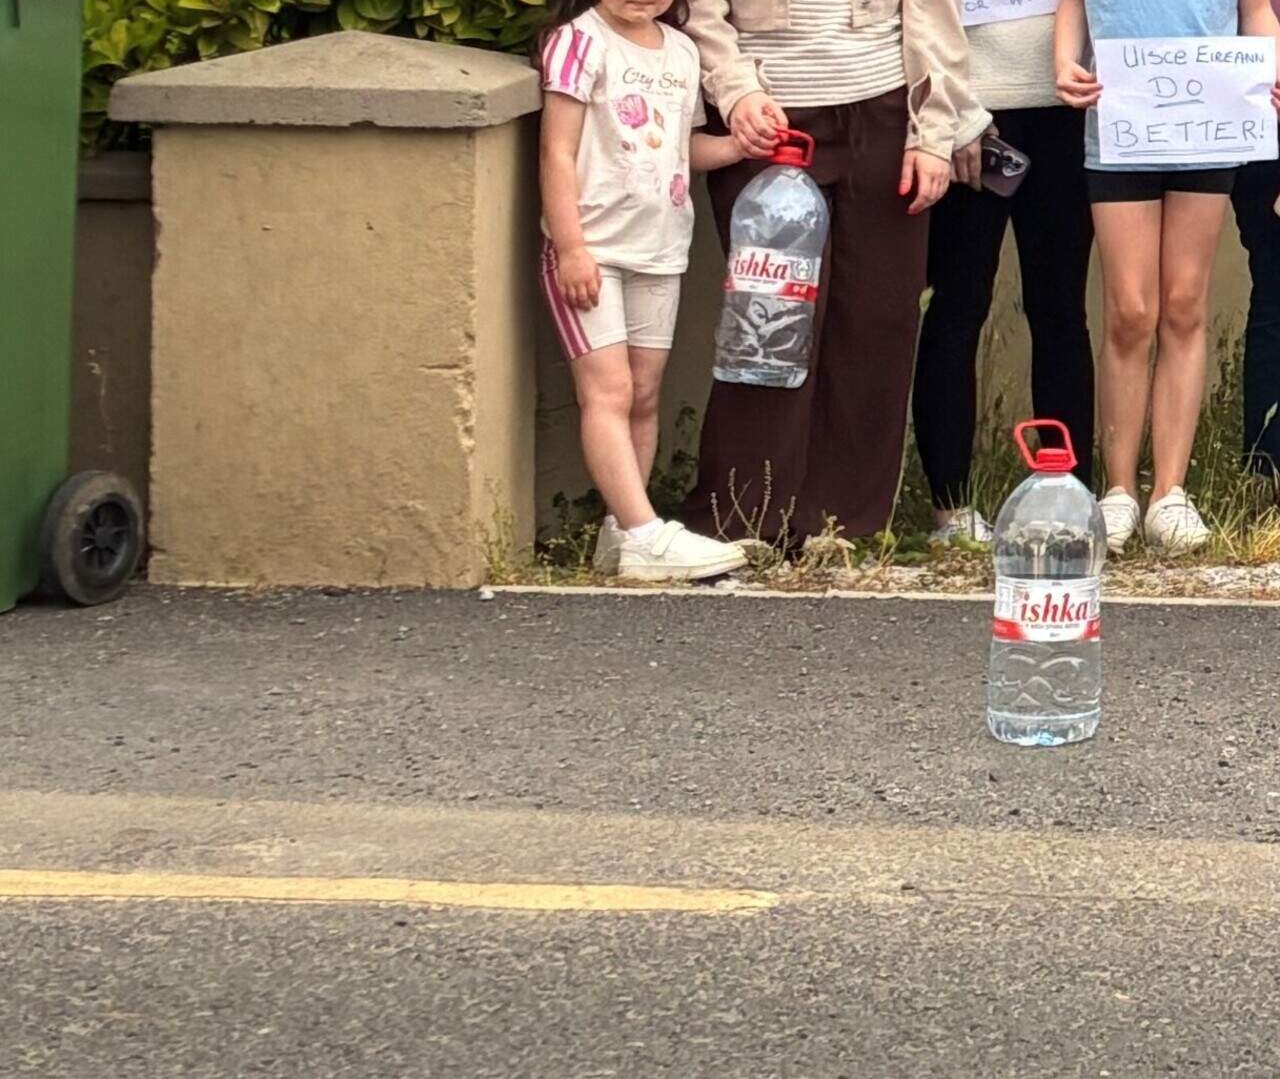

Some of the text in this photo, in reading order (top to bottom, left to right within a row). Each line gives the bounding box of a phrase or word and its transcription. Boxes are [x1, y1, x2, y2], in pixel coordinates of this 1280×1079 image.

[964, 0, 989, 12] OR
[1196, 45, 1265, 64] EIREANN
[1148, 76, 1203, 99] DO
[1110, 119, 1265, 148] BETTER!
[734, 251, 789, 280] ishka
[1020, 591, 1089, 623] ishka
